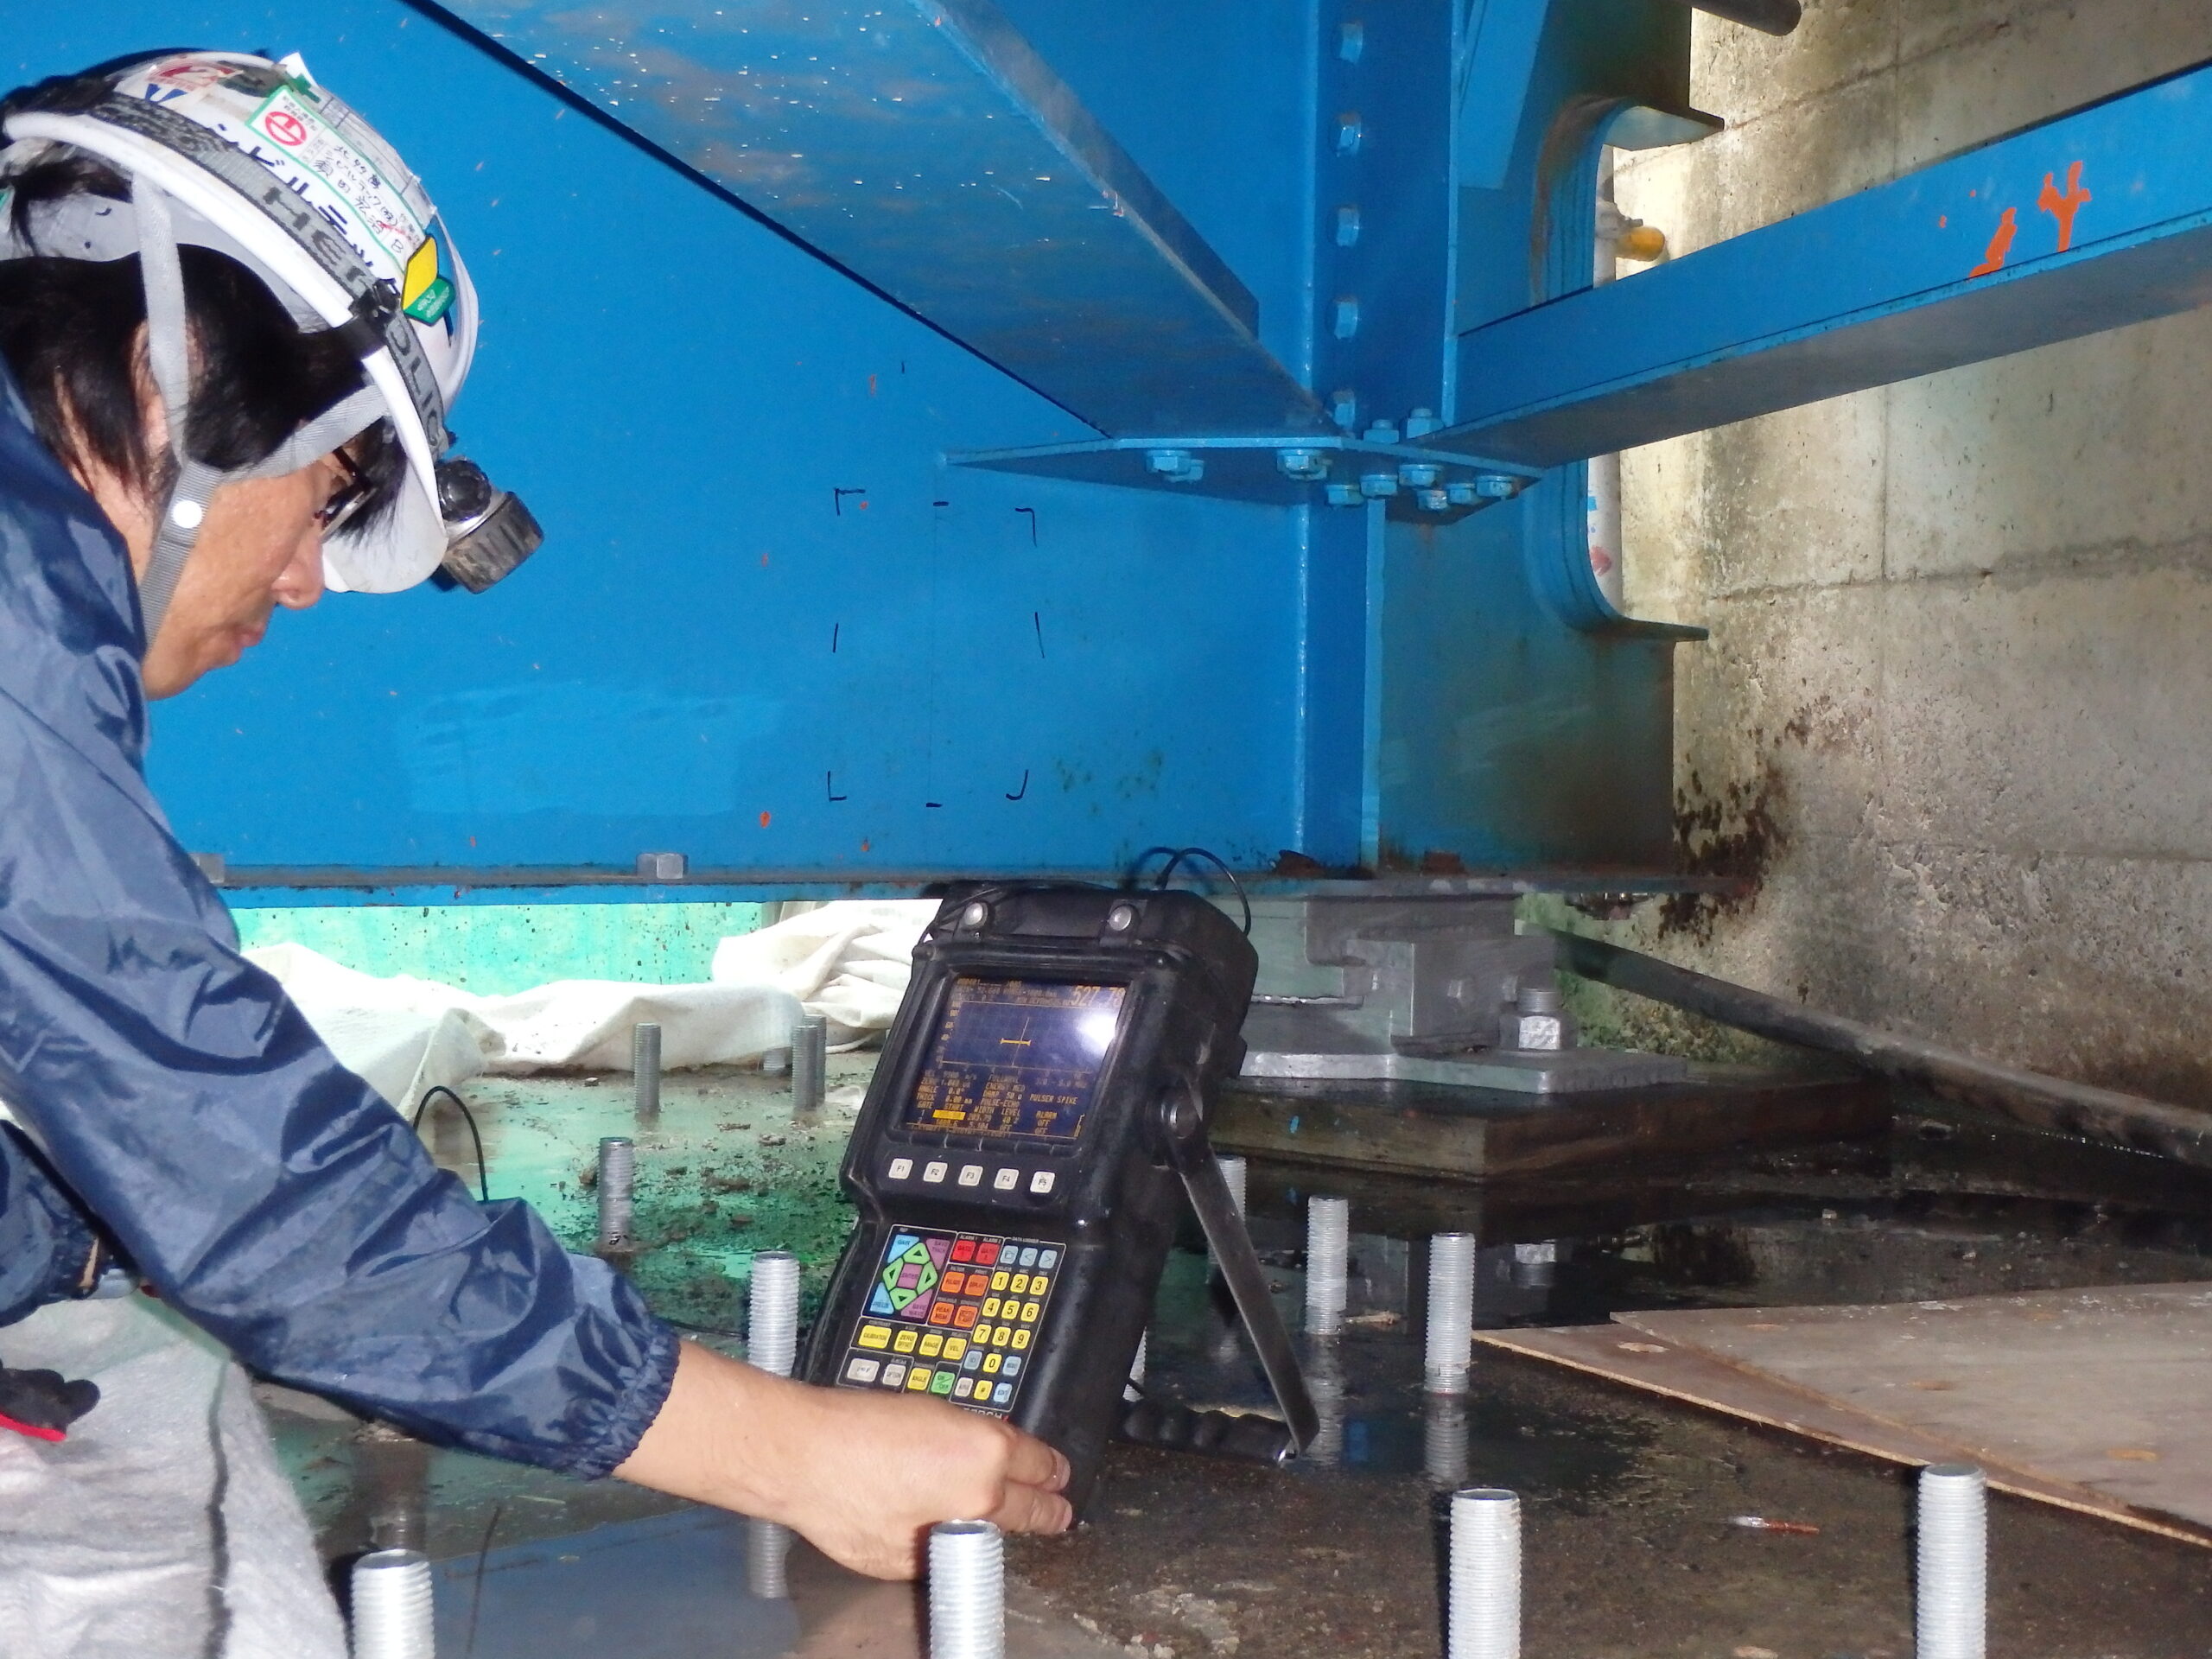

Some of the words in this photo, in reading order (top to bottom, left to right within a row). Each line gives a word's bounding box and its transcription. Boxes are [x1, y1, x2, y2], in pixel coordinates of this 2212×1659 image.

[1029, 1093, 1055, 1103] PULSER
[1057, 1096, 1078, 1105] SPIKE
[998, 1276, 1004, 1287] 1
[1015, 1279, 1024, 1288] 2
[1035, 1281, 1043, 1291] 3
[988, 1302, 995, 1313] 4
[1007, 1305, 1014, 1315] 5
[1027, 1307, 1034, 1318] 6
[979, 1328, 986, 1339] 7
[997, 1332, 1005, 1342] 8
[1017, 1333, 1025, 1344] 9
[988, 1358, 996, 1369] 0
